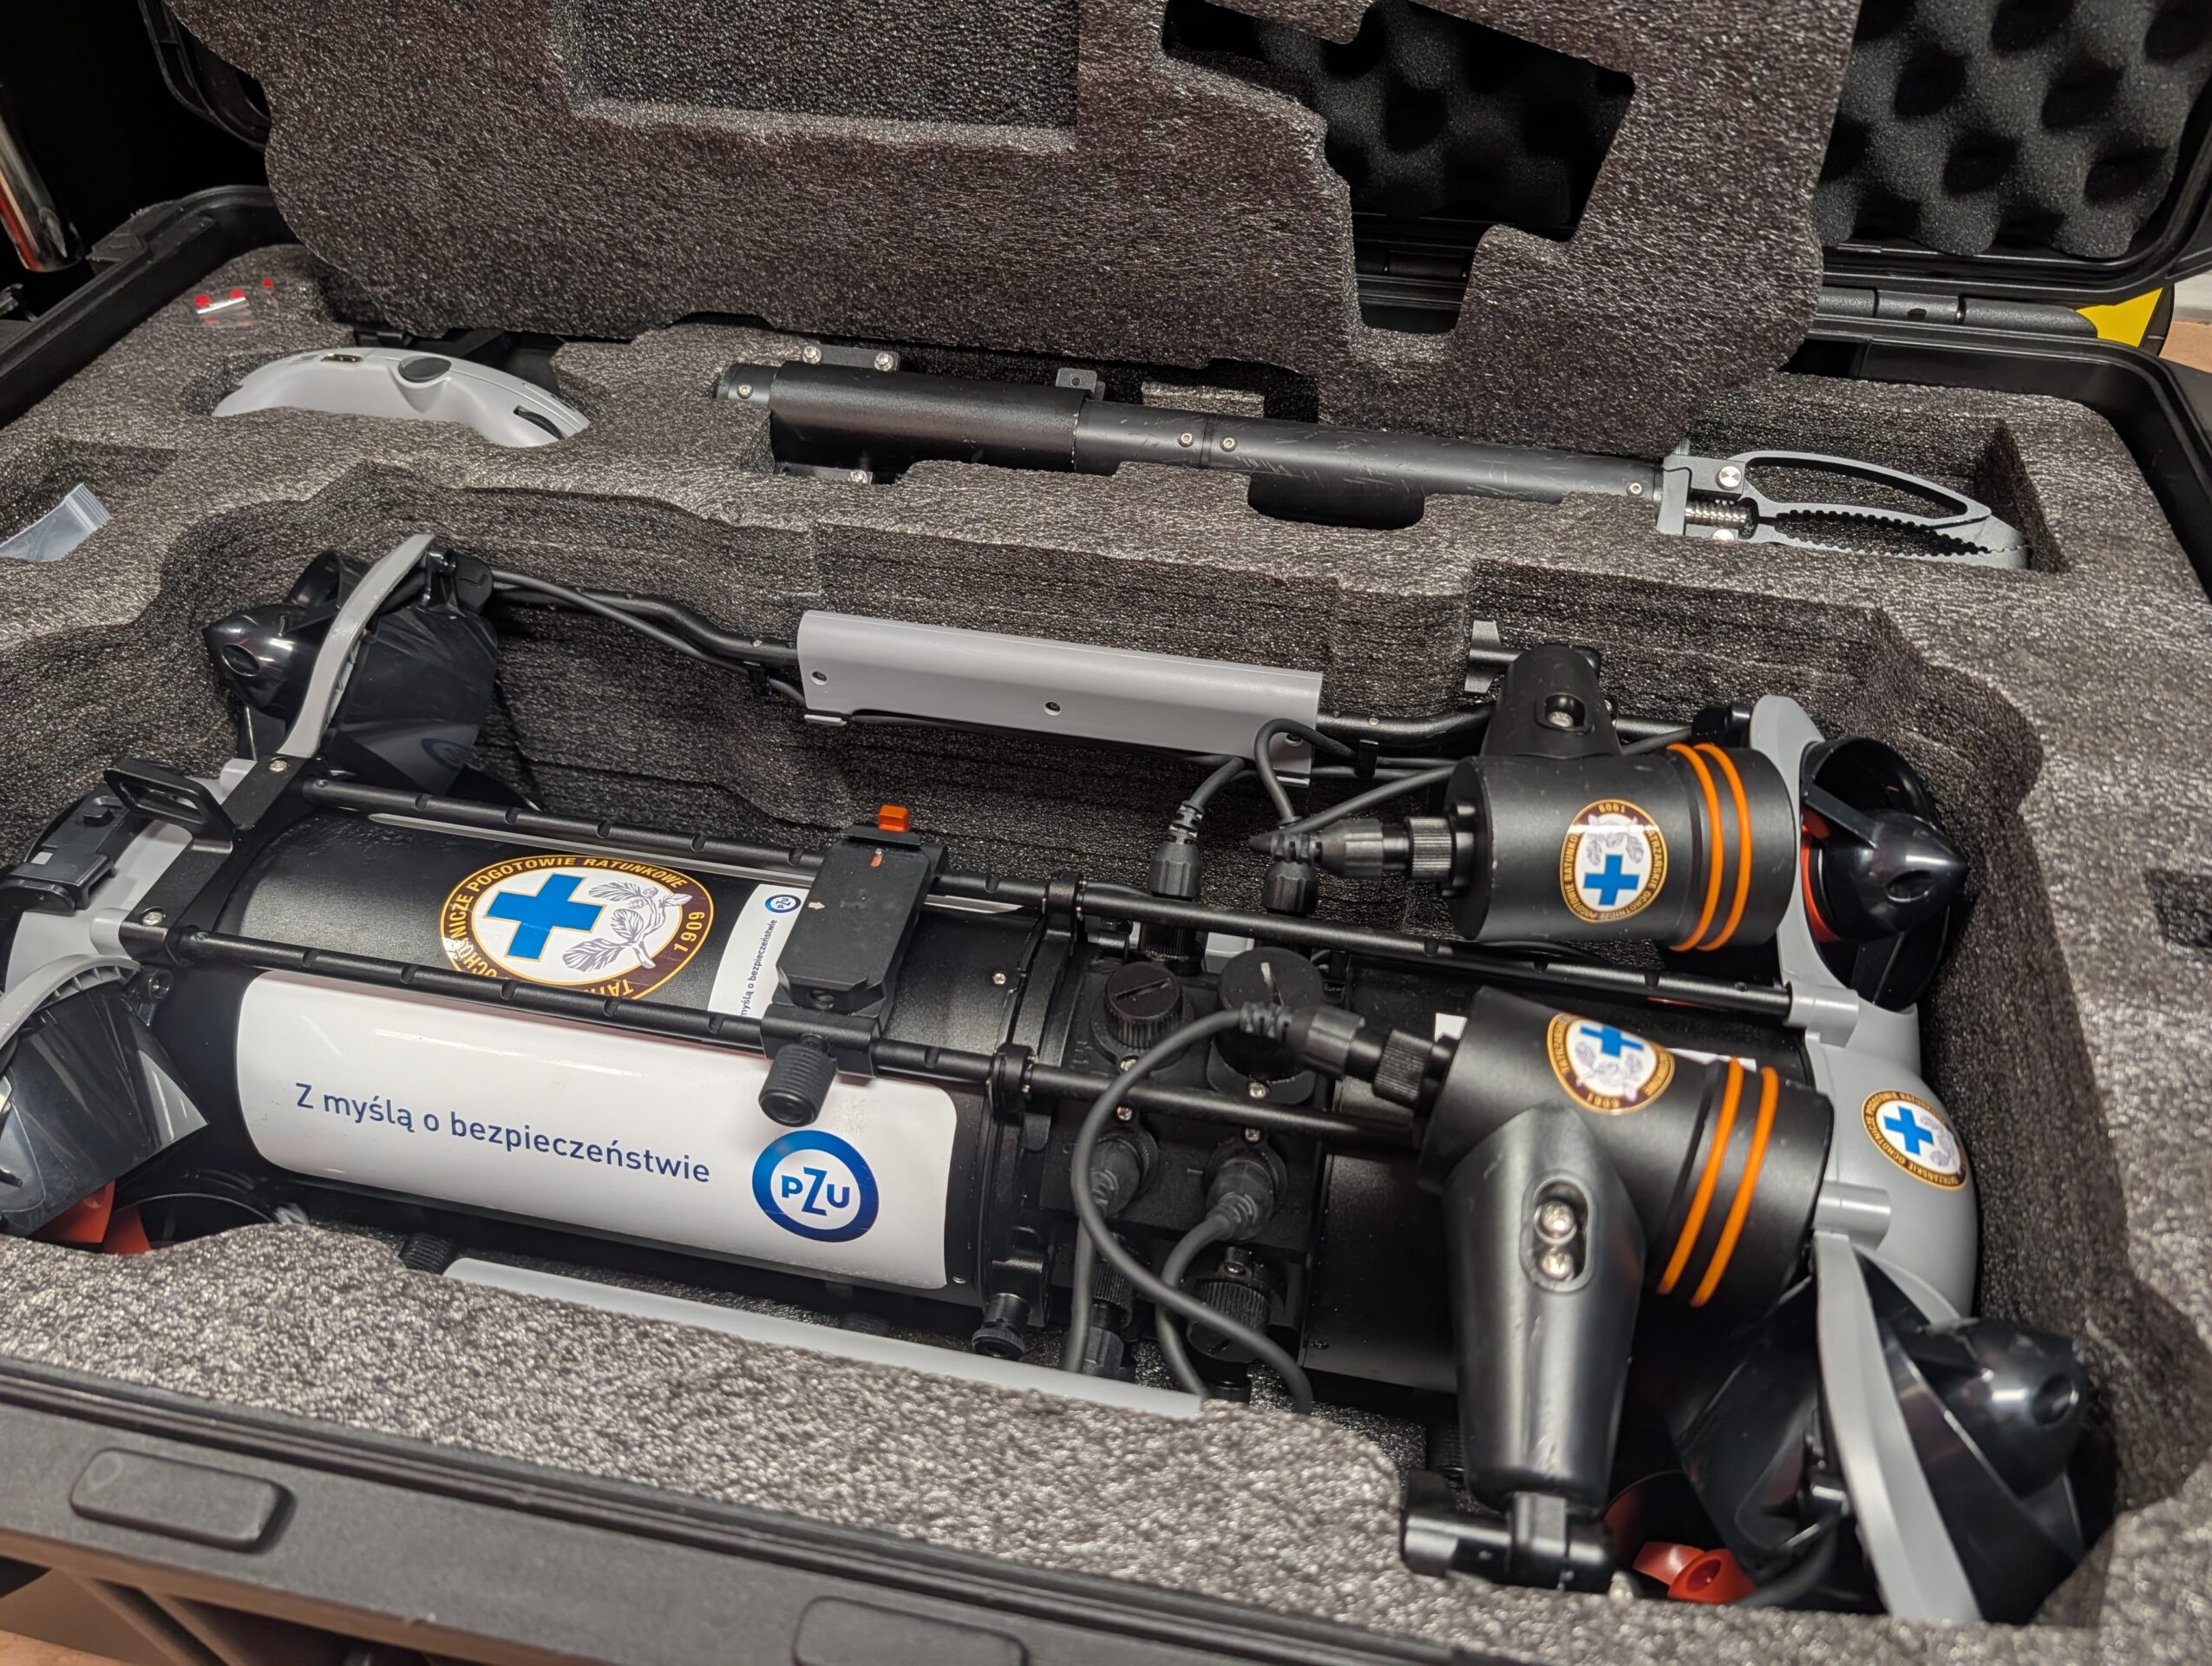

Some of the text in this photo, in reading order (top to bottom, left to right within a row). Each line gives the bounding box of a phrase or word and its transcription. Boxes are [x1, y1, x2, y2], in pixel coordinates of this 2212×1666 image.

[467, 857, 576, 892] POGOTOWIE
[584, 857, 688, 889] RATUNKOWE
[674, 911, 705, 953] 1909
[748, 919, 777, 981] bezpieczeństwie
[296, 1082, 710, 1183] Z myślą o bezpieczeństwie
[782, 1166, 850, 1217] PZU
